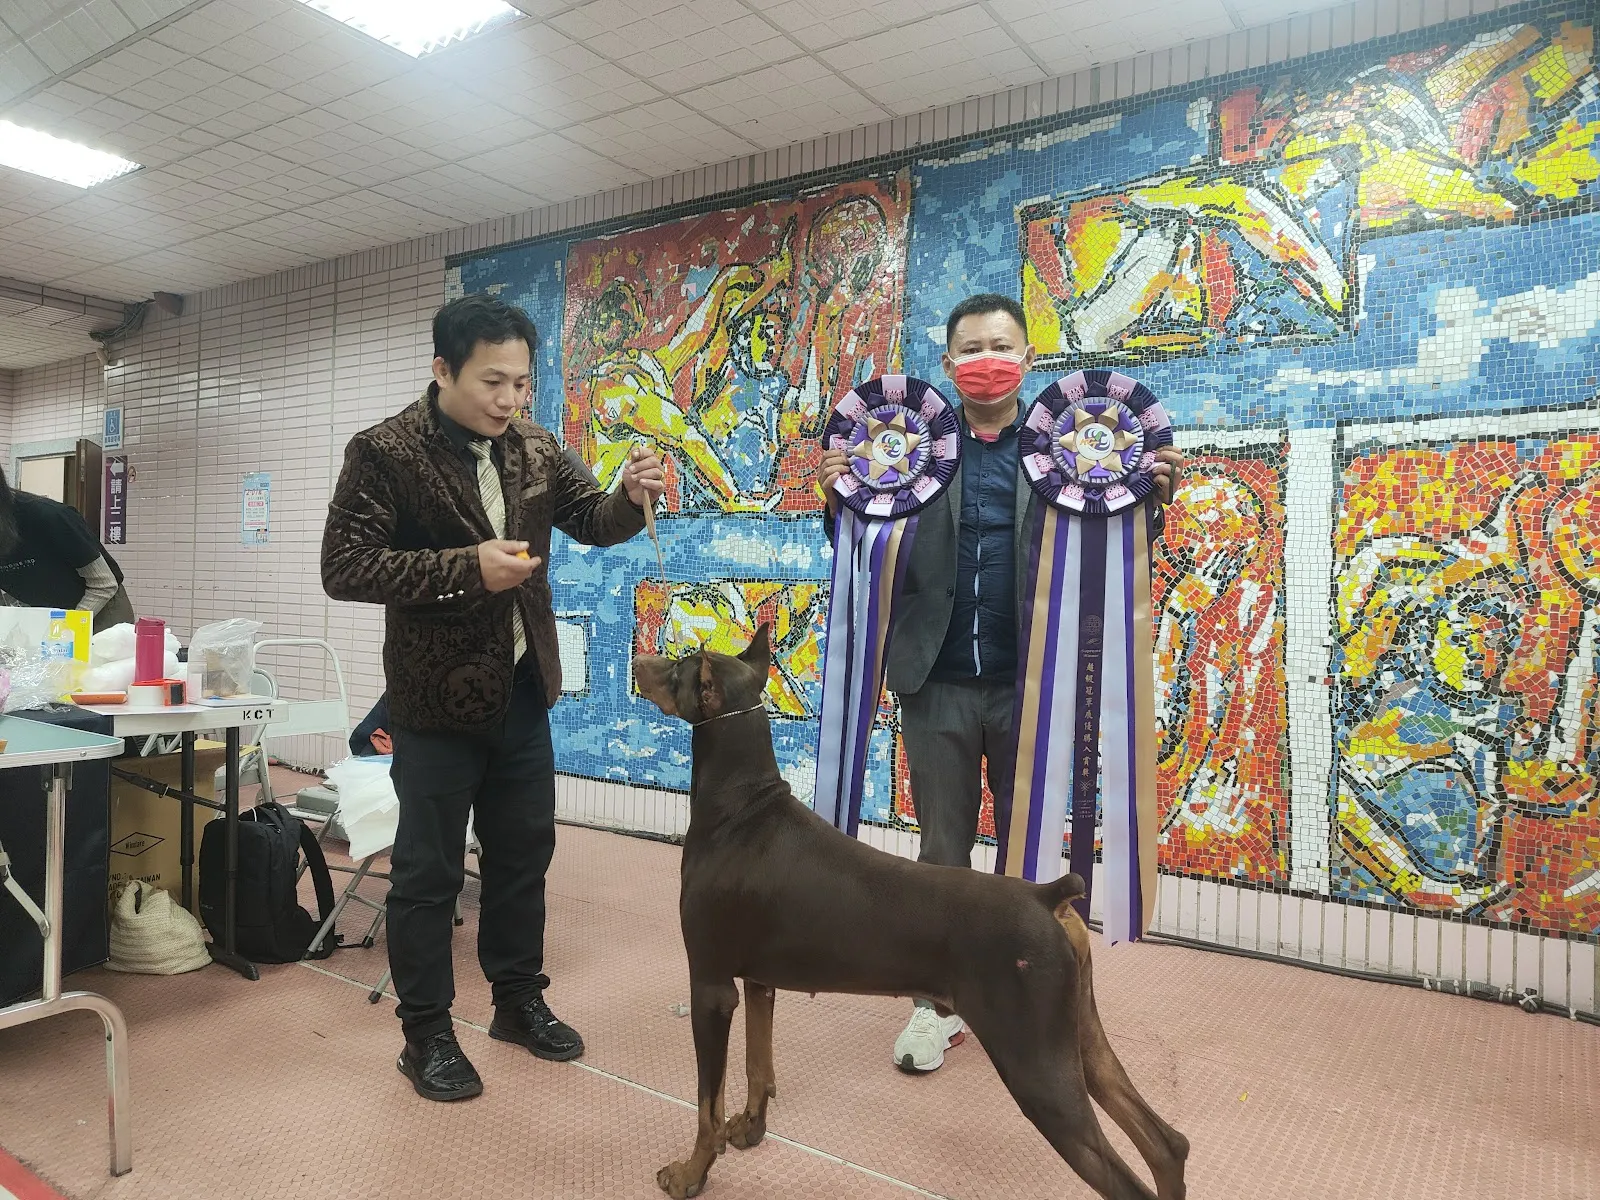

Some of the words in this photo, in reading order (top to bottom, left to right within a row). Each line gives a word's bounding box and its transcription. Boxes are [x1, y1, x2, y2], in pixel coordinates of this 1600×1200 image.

[110, 479, 123, 541] 請上二樓
[243, 709, 274, 721] KCT
